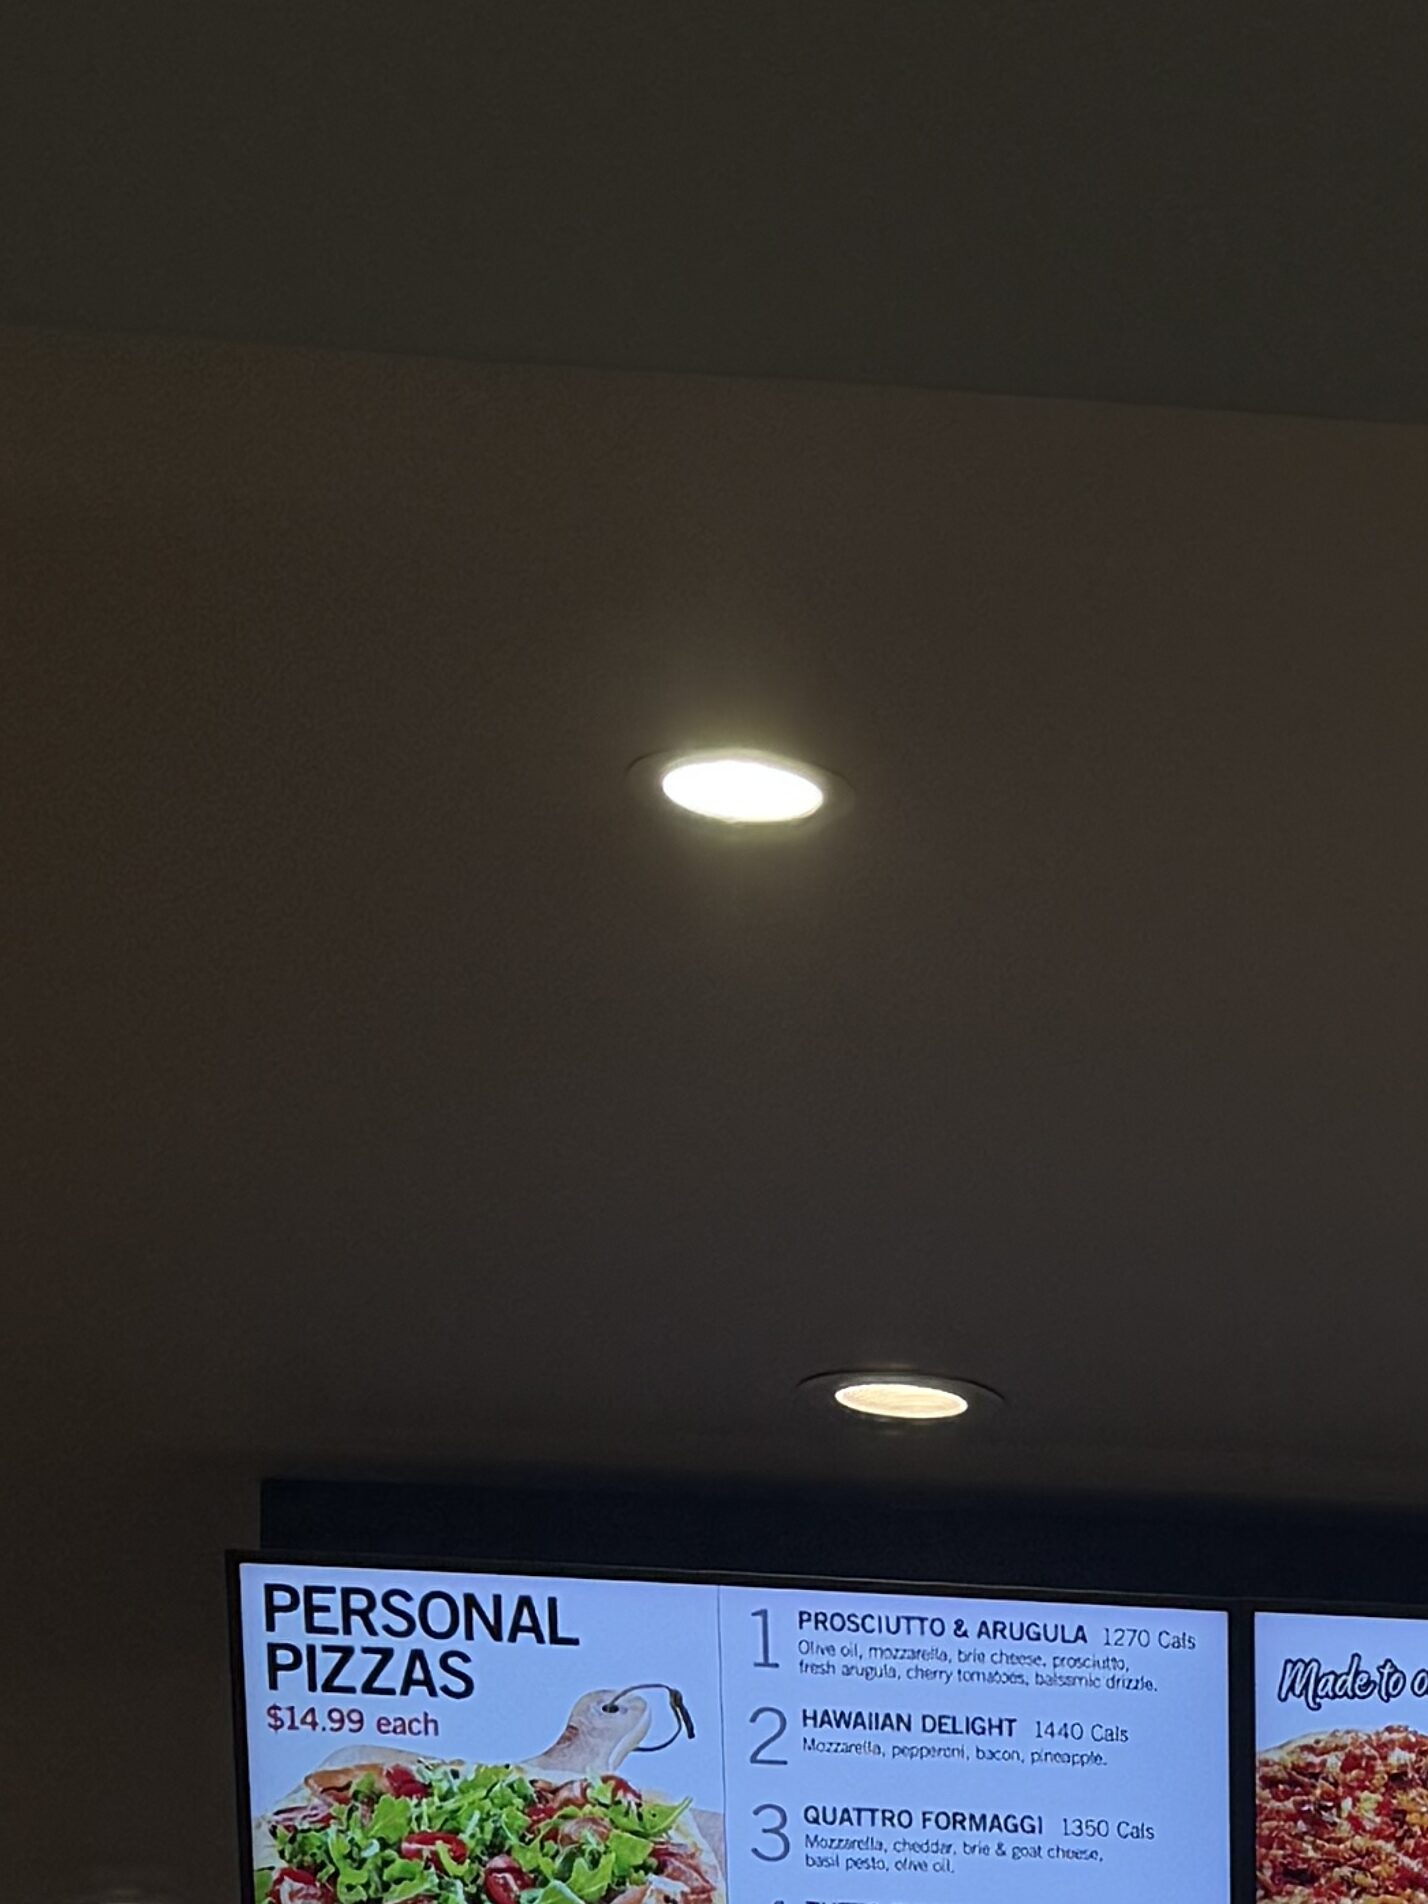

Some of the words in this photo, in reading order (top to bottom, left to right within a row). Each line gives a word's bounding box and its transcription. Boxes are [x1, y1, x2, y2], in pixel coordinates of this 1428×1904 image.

[263, 1583, 580, 1645] PERSONAL
[750, 1608, 780, 1669] 1
[798, 1610, 946, 1637] PROSCIUTTO
[953, 1618, 969, 1639] &
[976, 1620, 1088, 1644] ARUGULA
[1103, 1627, 1150, 1648] 1270
[1157, 1630, 1196, 1650] Cals
[266, 1642, 474, 1699] PIZZAS
[1278, 1653, 1377, 1711] Made
[1377, 1658, 1407, 1703] to
[266, 1704, 364, 1734] $14.99
[376, 1711, 439, 1737] each
[748, 1706, 788, 1766] 2
[802, 1709, 912, 1732] HAWAIIAN
[921, 1714, 1018, 1737] DELIGHT
[1035, 1720, 1084, 1741] 1440
[1090, 1723, 1129, 1743] Cals
[750, 1803, 790, 1862] 3
[803, 1805, 913, 1829] QUATTRO
[921, 1810, 1042, 1834] FORMAGGI
[1062, 1818, 1109, 1838] 1350
[1116, 1820, 1154, 1840] Cals
